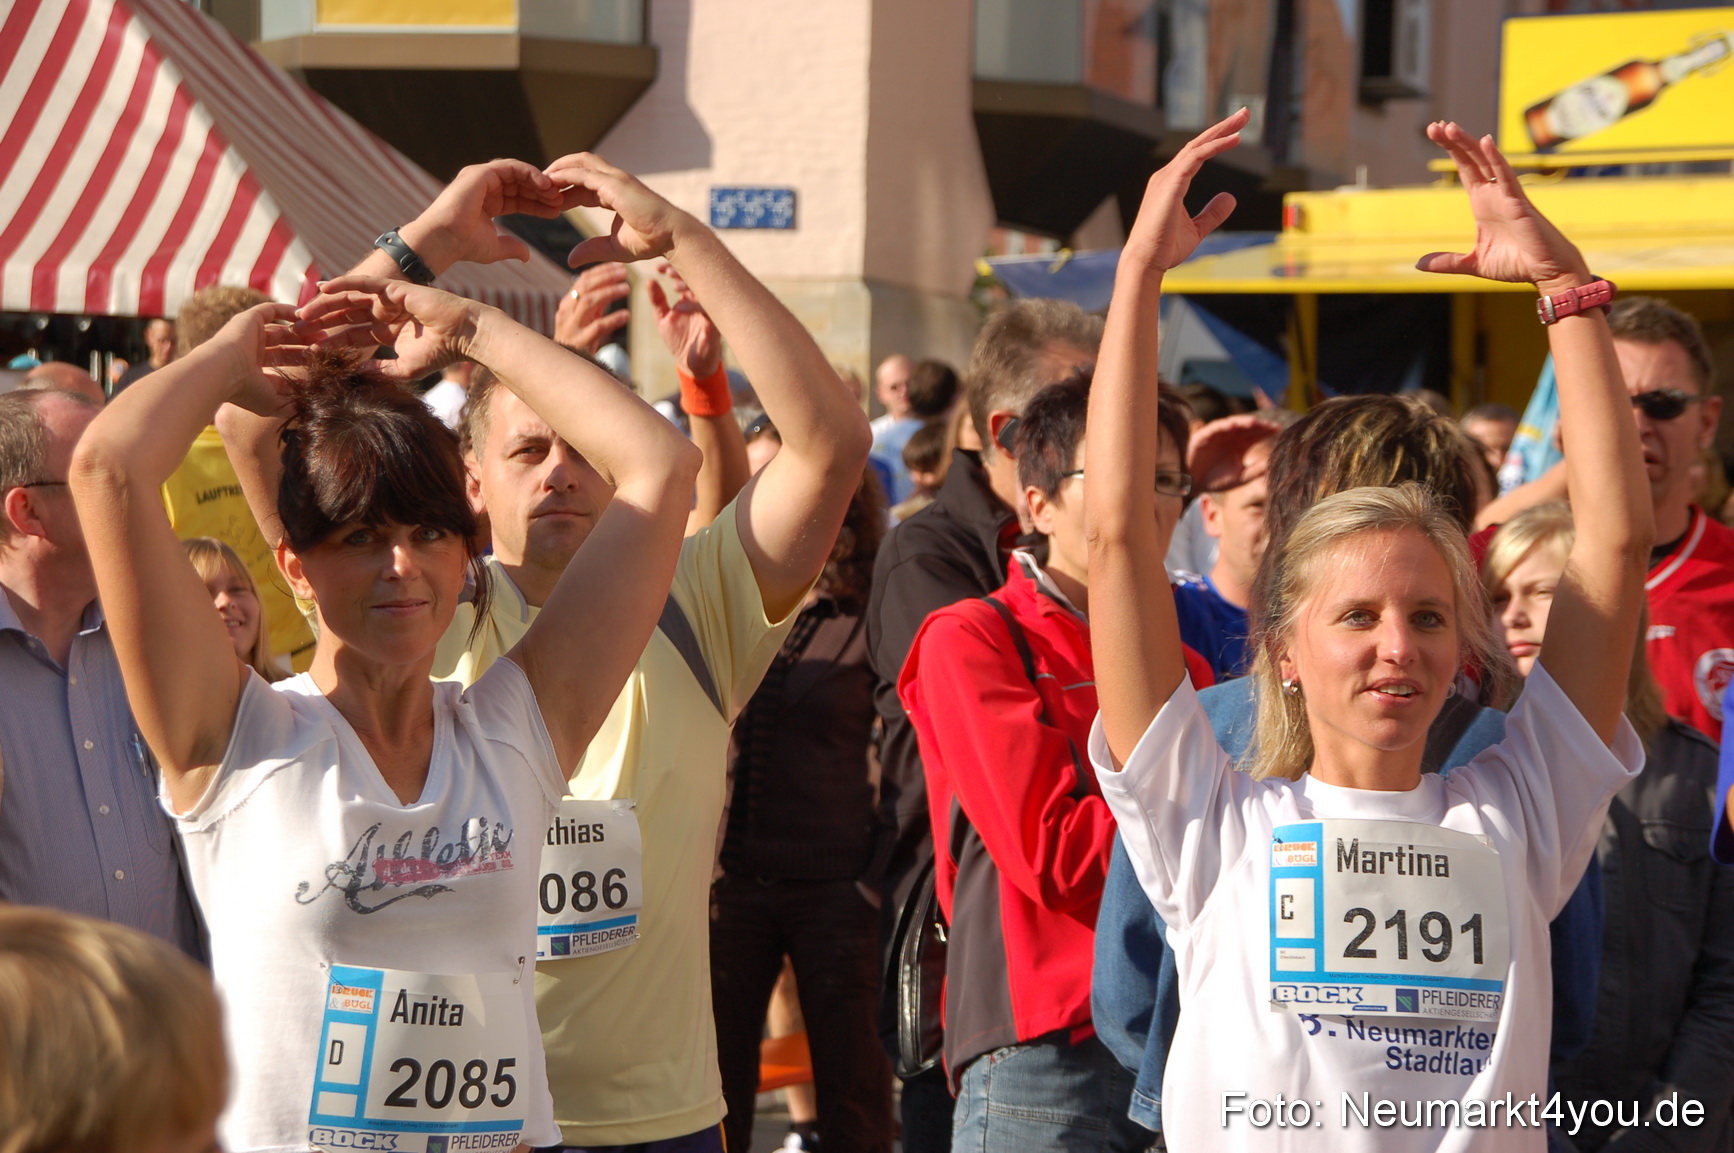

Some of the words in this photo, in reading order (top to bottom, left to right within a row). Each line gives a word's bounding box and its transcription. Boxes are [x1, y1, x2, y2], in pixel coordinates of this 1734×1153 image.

[542, 817, 604, 846] thias
[1336, 837, 1450, 878] Martina
[1280, 894, 1294, 920] C
[572, 925, 636, 947] PFLEIDERER
[1342, 907, 1484, 965] 2191
[389, 988, 465, 1027] Anita
[1272, 984, 1364, 1004] BOCK
[1422, 989, 1502, 1010] PFLEIDERER
[329, 1039, 345, 1066] D
[1385, 1045, 1493, 1077] Stadtlau
[383, 1057, 517, 1110] 2085
[308, 1127, 400, 1151] BOCK
[451, 1132, 520, 1150] PFLEIDERER
